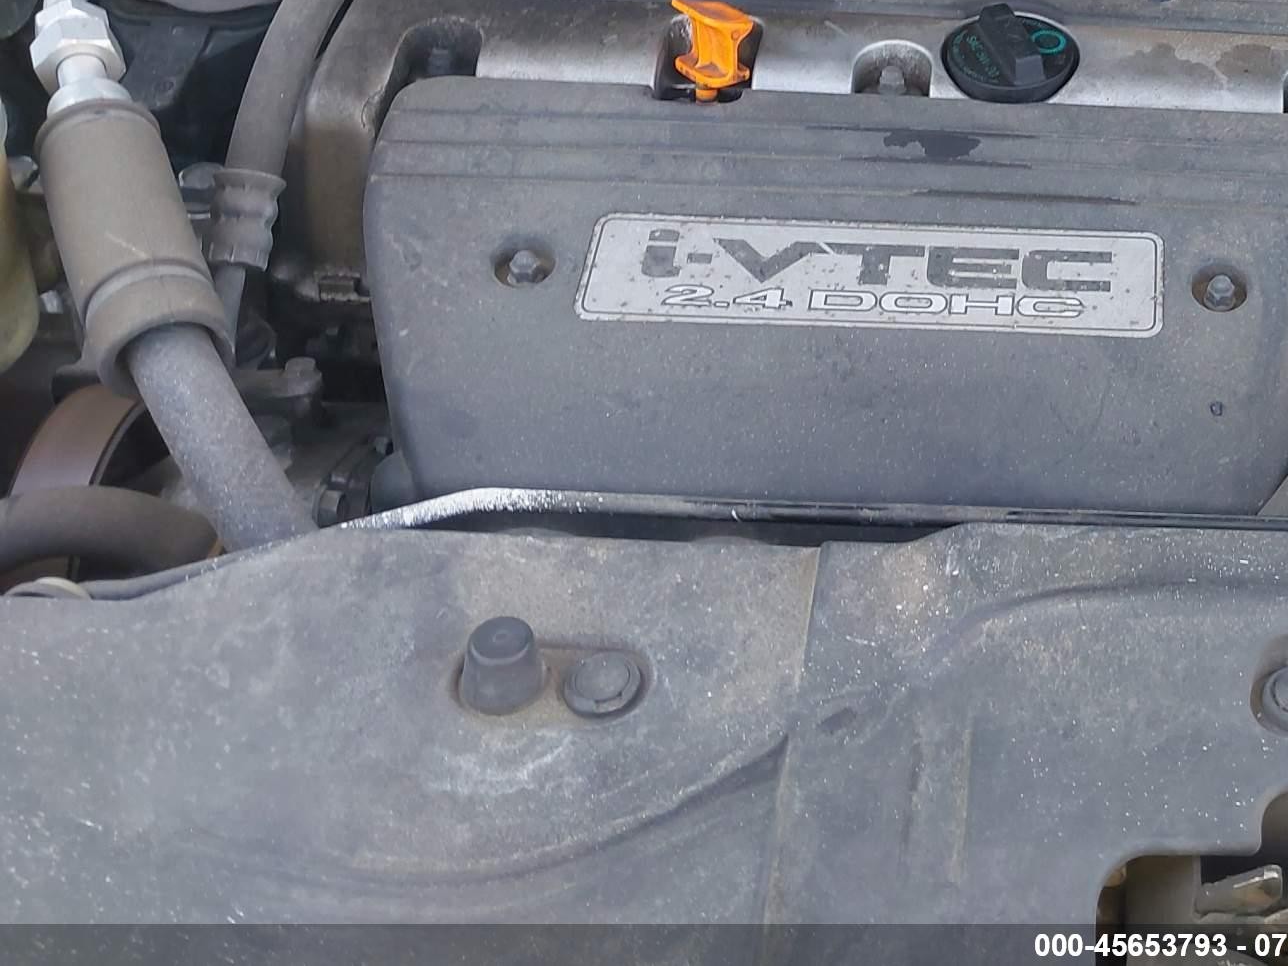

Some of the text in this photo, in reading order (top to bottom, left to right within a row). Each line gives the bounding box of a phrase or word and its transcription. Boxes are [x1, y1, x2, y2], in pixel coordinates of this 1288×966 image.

[642, 228, 1113, 292] i-VTEC
[663, 284, 1087, 319] 2.4 DOHC
